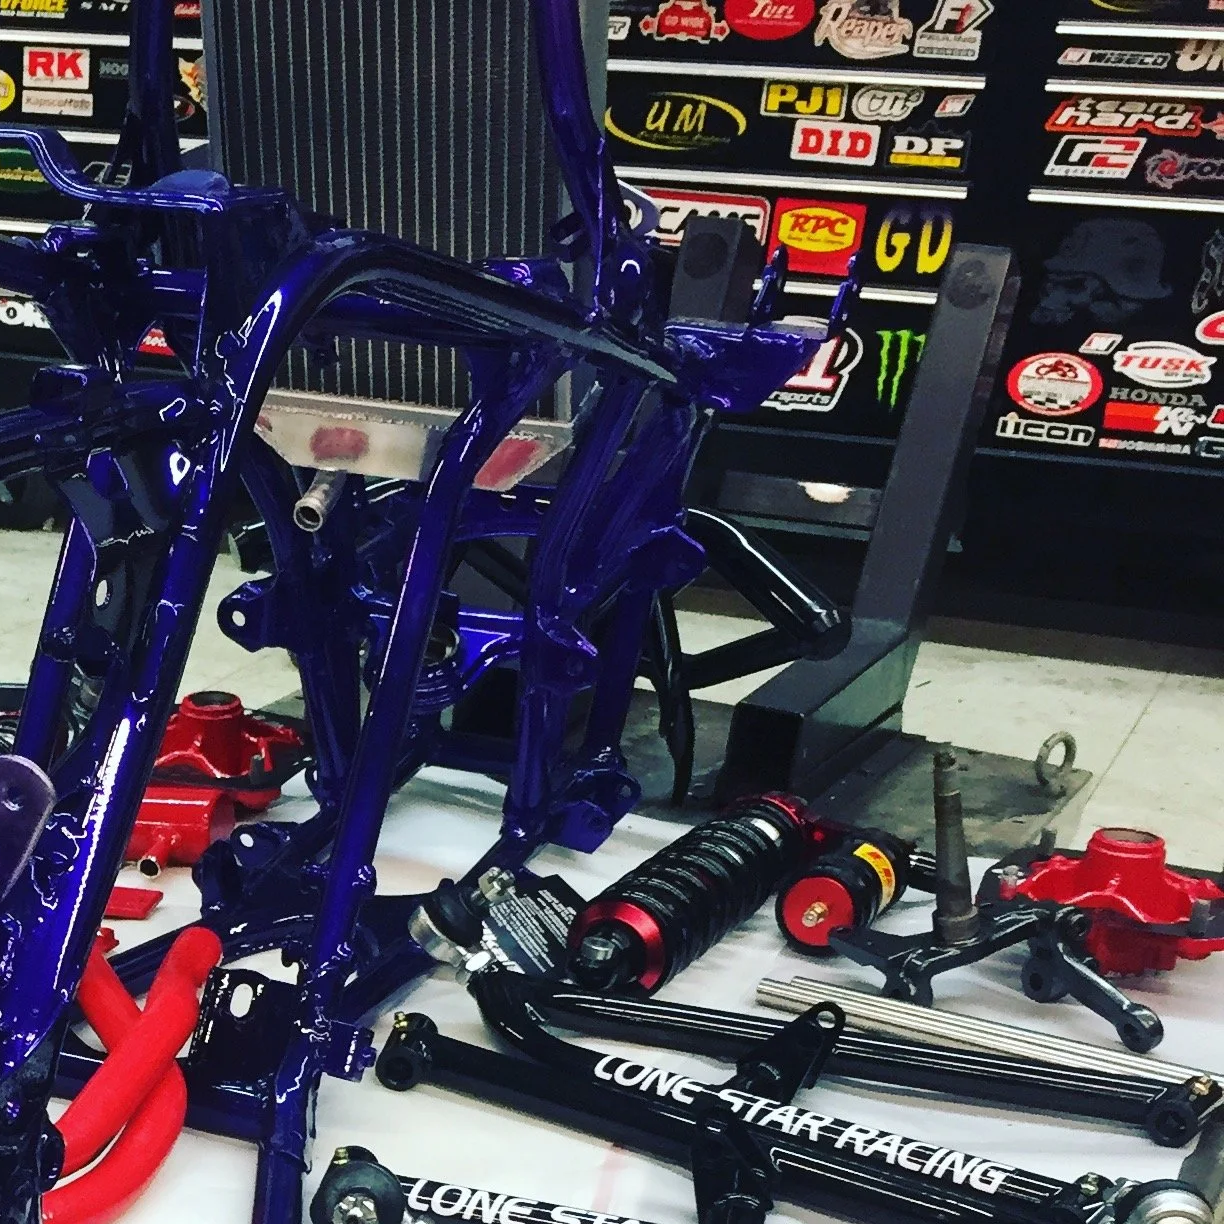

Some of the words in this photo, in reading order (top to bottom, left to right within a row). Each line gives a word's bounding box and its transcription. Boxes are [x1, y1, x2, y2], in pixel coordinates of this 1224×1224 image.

[28, 51, 83, 78] RK
[766, 84, 843, 116] PJ1
[1077, 97, 1187, 115] team
[891, 135, 964, 156] DP
[790, 212, 849, 237] RPC
[1119, 354, 1208, 373] TUSK
[1108, 387, 1208, 407] HONDA
[594, 1053, 708, 1105] LONE
[716, 1088, 834, 1142] STAR
[835, 1123, 1015, 1196] RACING
